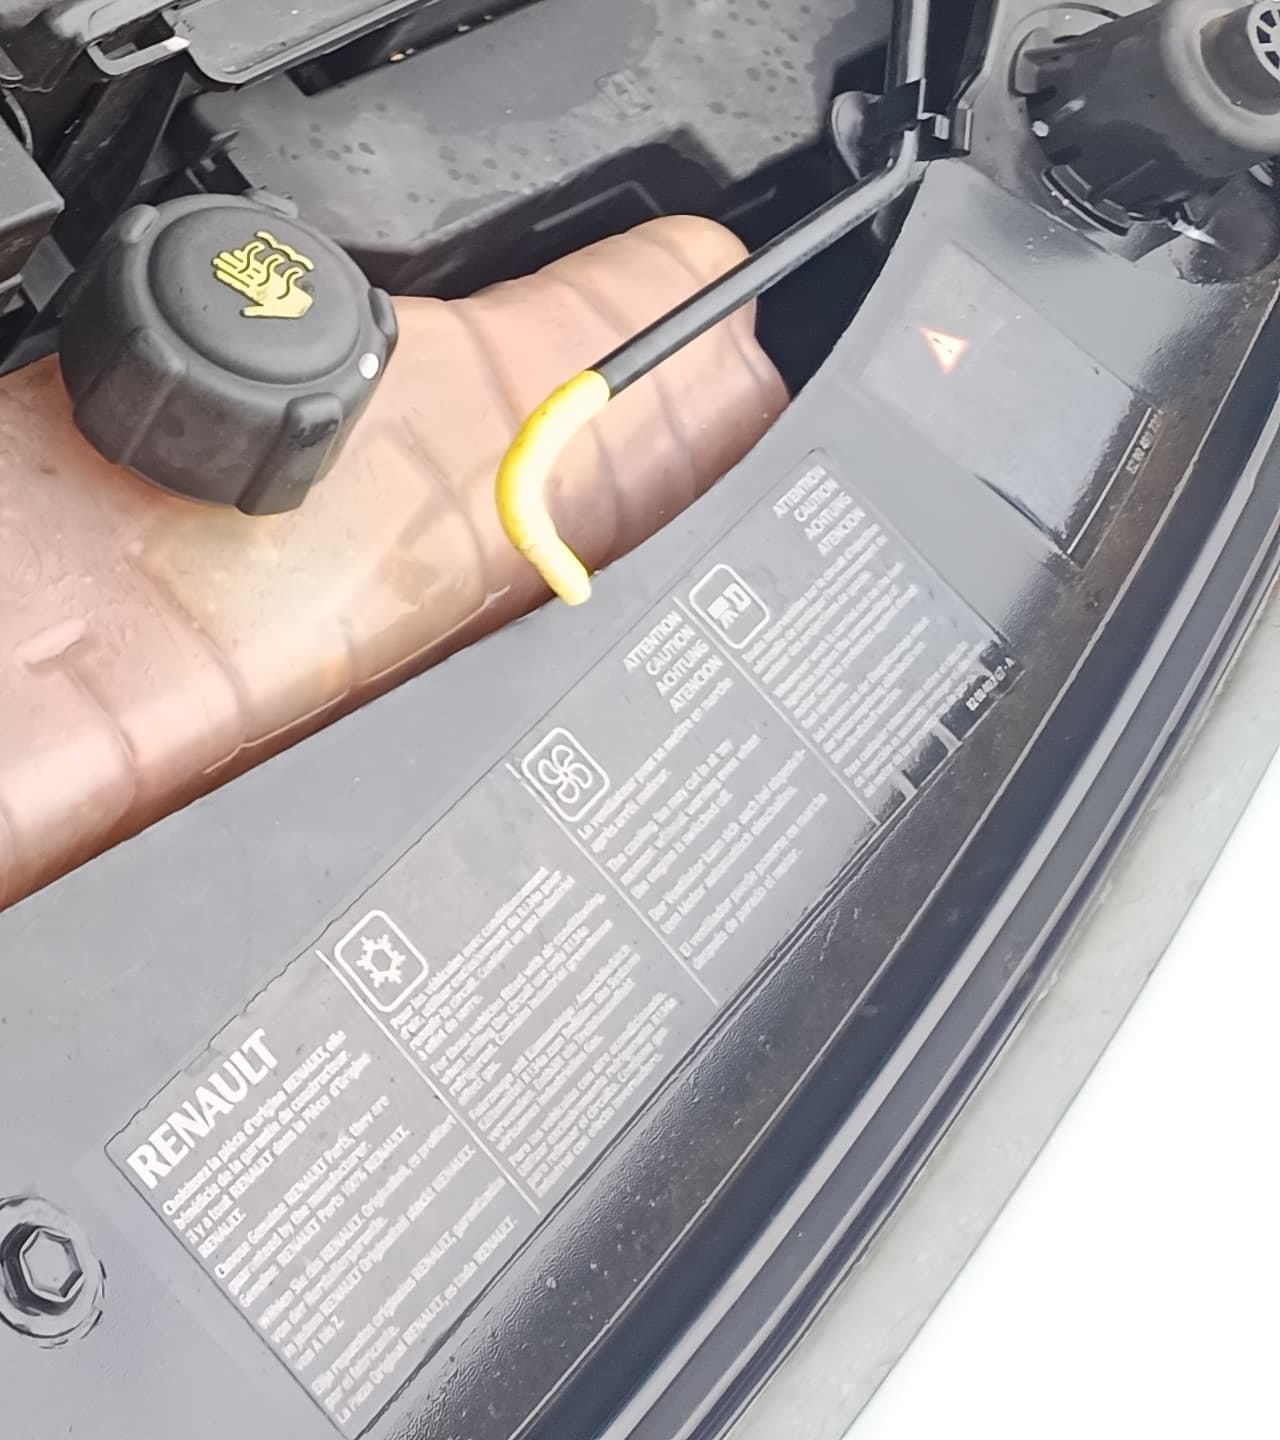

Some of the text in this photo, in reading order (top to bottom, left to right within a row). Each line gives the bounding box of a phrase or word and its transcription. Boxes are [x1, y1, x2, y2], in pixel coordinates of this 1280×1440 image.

[623, 610, 683, 672] ATTENTION
[646, 624, 696, 675] CAUTION
[656, 639, 710, 696] ACHTUNG
[126, 1028, 277, 1189] RENAULT
